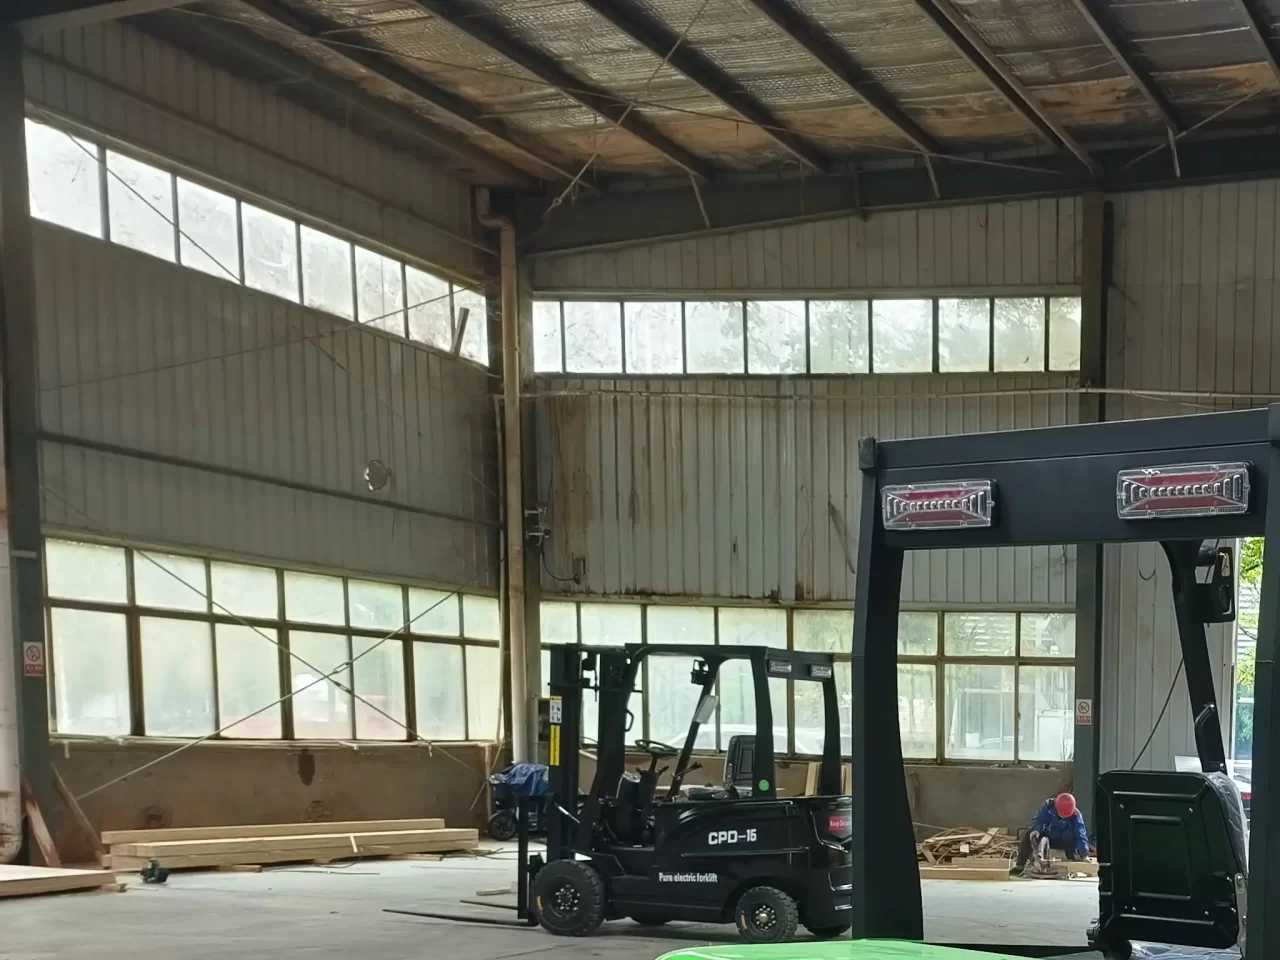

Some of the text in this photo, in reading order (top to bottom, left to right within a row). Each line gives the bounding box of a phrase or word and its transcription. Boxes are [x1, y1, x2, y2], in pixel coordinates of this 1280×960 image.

[708, 828, 757, 845] CPD-15
[659, 872, 718, 882] Pure electric forklift
